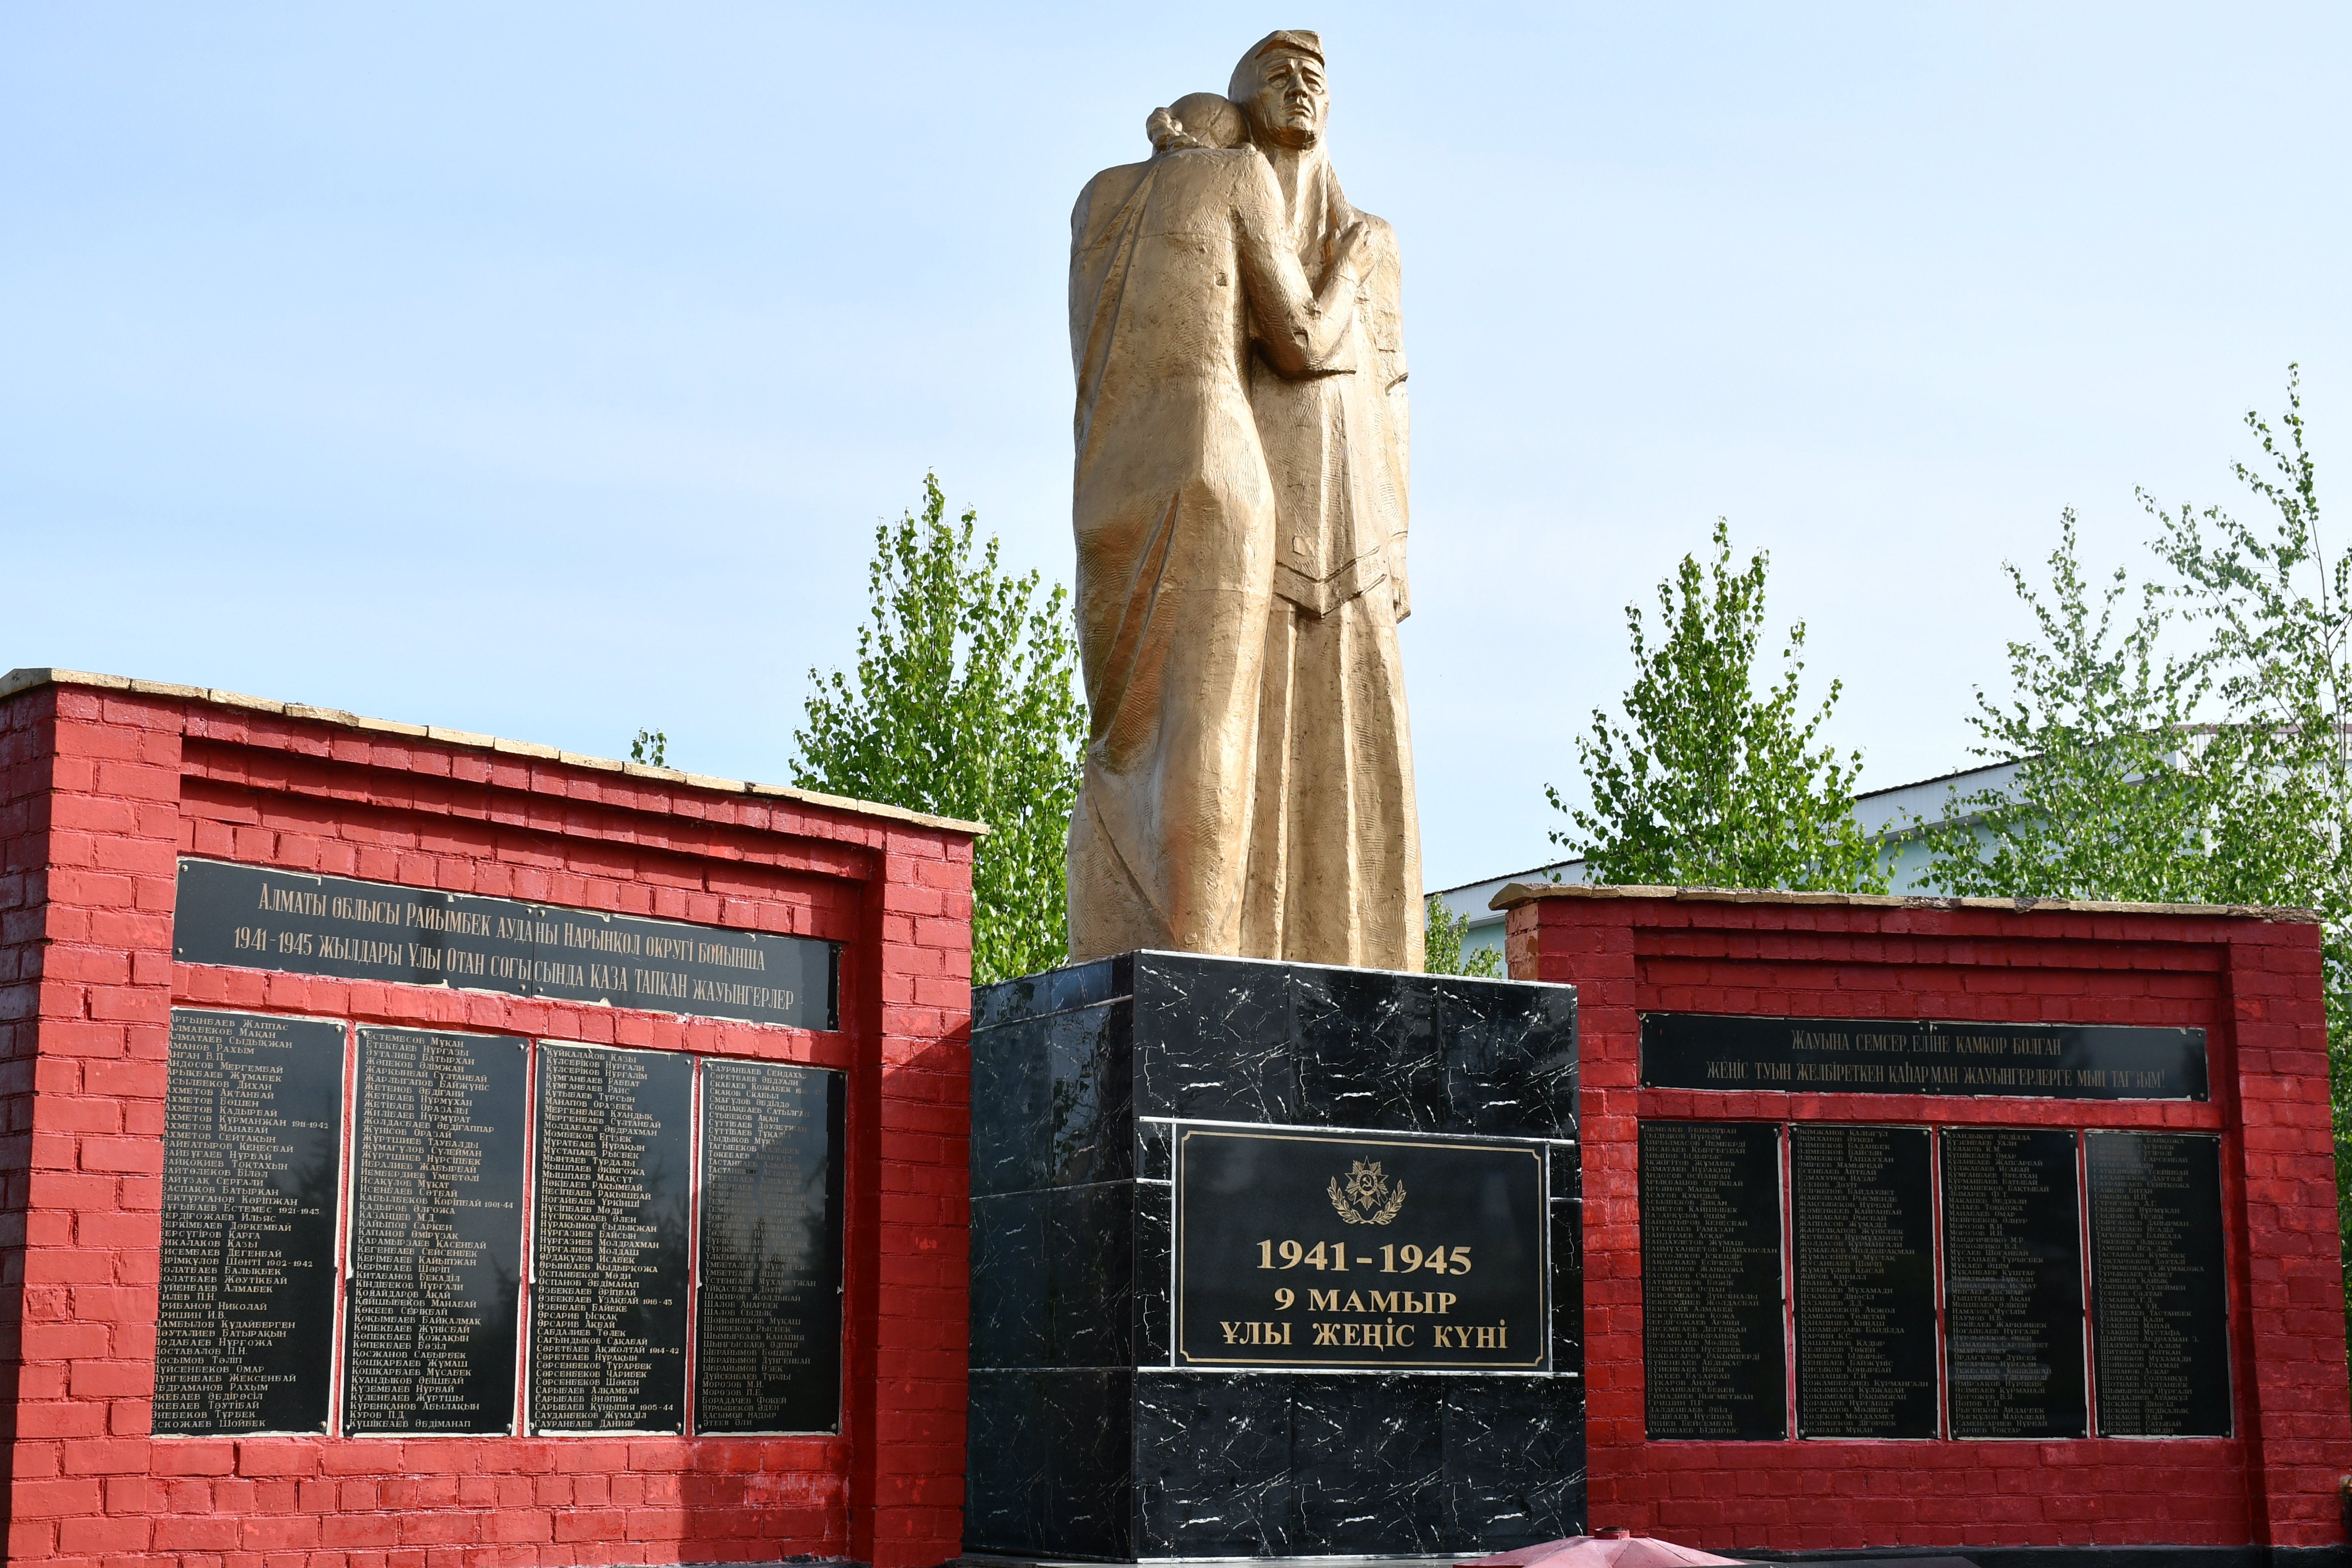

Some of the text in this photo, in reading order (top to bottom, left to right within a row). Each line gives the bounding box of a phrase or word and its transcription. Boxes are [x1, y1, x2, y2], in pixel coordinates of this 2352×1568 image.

[257, 883, 327, 917] АЛМАТЫ
[332, 896, 398, 925] ОБЛЫСЫ
[406, 902, 490, 936] РАЙЫМБЕК
[495, 913, 558, 945] АУДАНЫ
[564, 923, 640, 957] НАРЫНҚОЛ
[698, 940, 765, 971] БОЙЫНША
[318, 935, 402, 966] ЖЫЛДАРЫ
[408, 942, 441, 970] ҰЛЫ
[447, 947, 485, 975] ОТАН
[490, 956, 584, 989] СОҒЫСЫНДА
[590, 964, 628, 993] ҚАЗА
[634, 969, 687, 999] ТАПҚАН
[692, 979, 794, 1010] ЖАУЫНГЕРЛЕР
[242, 1019, 289, 1031] ЖАППАС
[366, 1039, 417, 1052] ЕТЕКБАЕВ
[1791, 1030, 1850, 1051] ЖАУЫНА
[216, 1043, 255, 1054] РАХЫМ
[366, 1048, 475, 1065] ӘУТАЛИЕВ БАТЫРХАН
[220, 1061, 283, 1074] МЕРГЕМБАЙ
[1754, 1062, 1791, 1080] ТУЫН
[1963, 1067, 2072, 1086] ЖАУЫНГЕРЛЕРГЕ
[237, 1081, 272, 1091] ДИХАН
[762, 1076, 798, 1086] ӘБДУАЛИ
[220, 1097, 259, 1107] БӨШЕН
[544, 1097, 633, 1111] МАНАПОВ ОРАЗБЕК
[544, 1105, 604, 1116] МЕРГЕНБАЕВ
[218, 1123, 268, 1134] МАНАБАЙ
[544, 1121, 657, 1136] МОЛДАБАЕВ ӘБДРАХМАН
[428, 1138, 479, 1150] ТАУБАЛДЫ
[361, 1158, 476, 1173] ИБРАЛИЕВ ЖАБЫРБАЙ
[542, 1170, 591, 1180] МЫШПАЕВ
[360, 1184, 412, 1195] ИСЕНБАЕВ
[223, 1203, 272, 1213] ЕСТЕМЕС
[359, 1210, 411, 1221] КАЗАНЦЕВ
[357, 1244, 478, 1257] КЕГЕНБАЕВ СЕЙСЕНБЕК
[539, 1269, 599, 1278] ОСПАНБЕКОВ
[223, 1283, 273, 1293] АЛМАБЕК
[538, 1294, 592, 1303] ӨЗБЕКБАЕВ
[704, 1292, 801, 1302] ШАКИРОВ ЖОЛДЫБАЙ
[1274, 1288, 1456, 1314] 9 МАМЫР
[218, 1301, 267, 1310] НИКОЛАЙ
[538, 1302, 627, 1312] ӨЗЕНБАЕВ БАЙЕКЕ
[704, 1300, 778, 1309] ШАЛОВ АНАРБЕК
[537, 1327, 626, 1337] САБДАЛИЕВ ТӨЛЕК
[704, 1324, 751, 1332] ШОЙБЕКОВ
[1220, 1321, 1292, 1345] ҰЛЫ
[414, 1350, 466, 1359] САБЫРБЕК
[703, 1364, 783, 1372] ЫБРАЙЫМОВ ӨЗЕК
[607, 1369, 647, 1378] ЧАРИБЕК
[230, 1383, 268, 1391] РАХЫМ
[702, 1380, 742, 1388] МОРОЗОВ
[536, 1386, 585, 1394] САРЫБАЕВ
[535, 1394, 585, 1402] САРЫБАЕВ
[702, 1396, 787, 1405] БОРАДАЧЕВ ФОКЕЙ
[350, 1410, 382, 1420] КУРОВ
[534, 1419, 634, 1429] САУРАНБАЕВ ДАНИЯР
